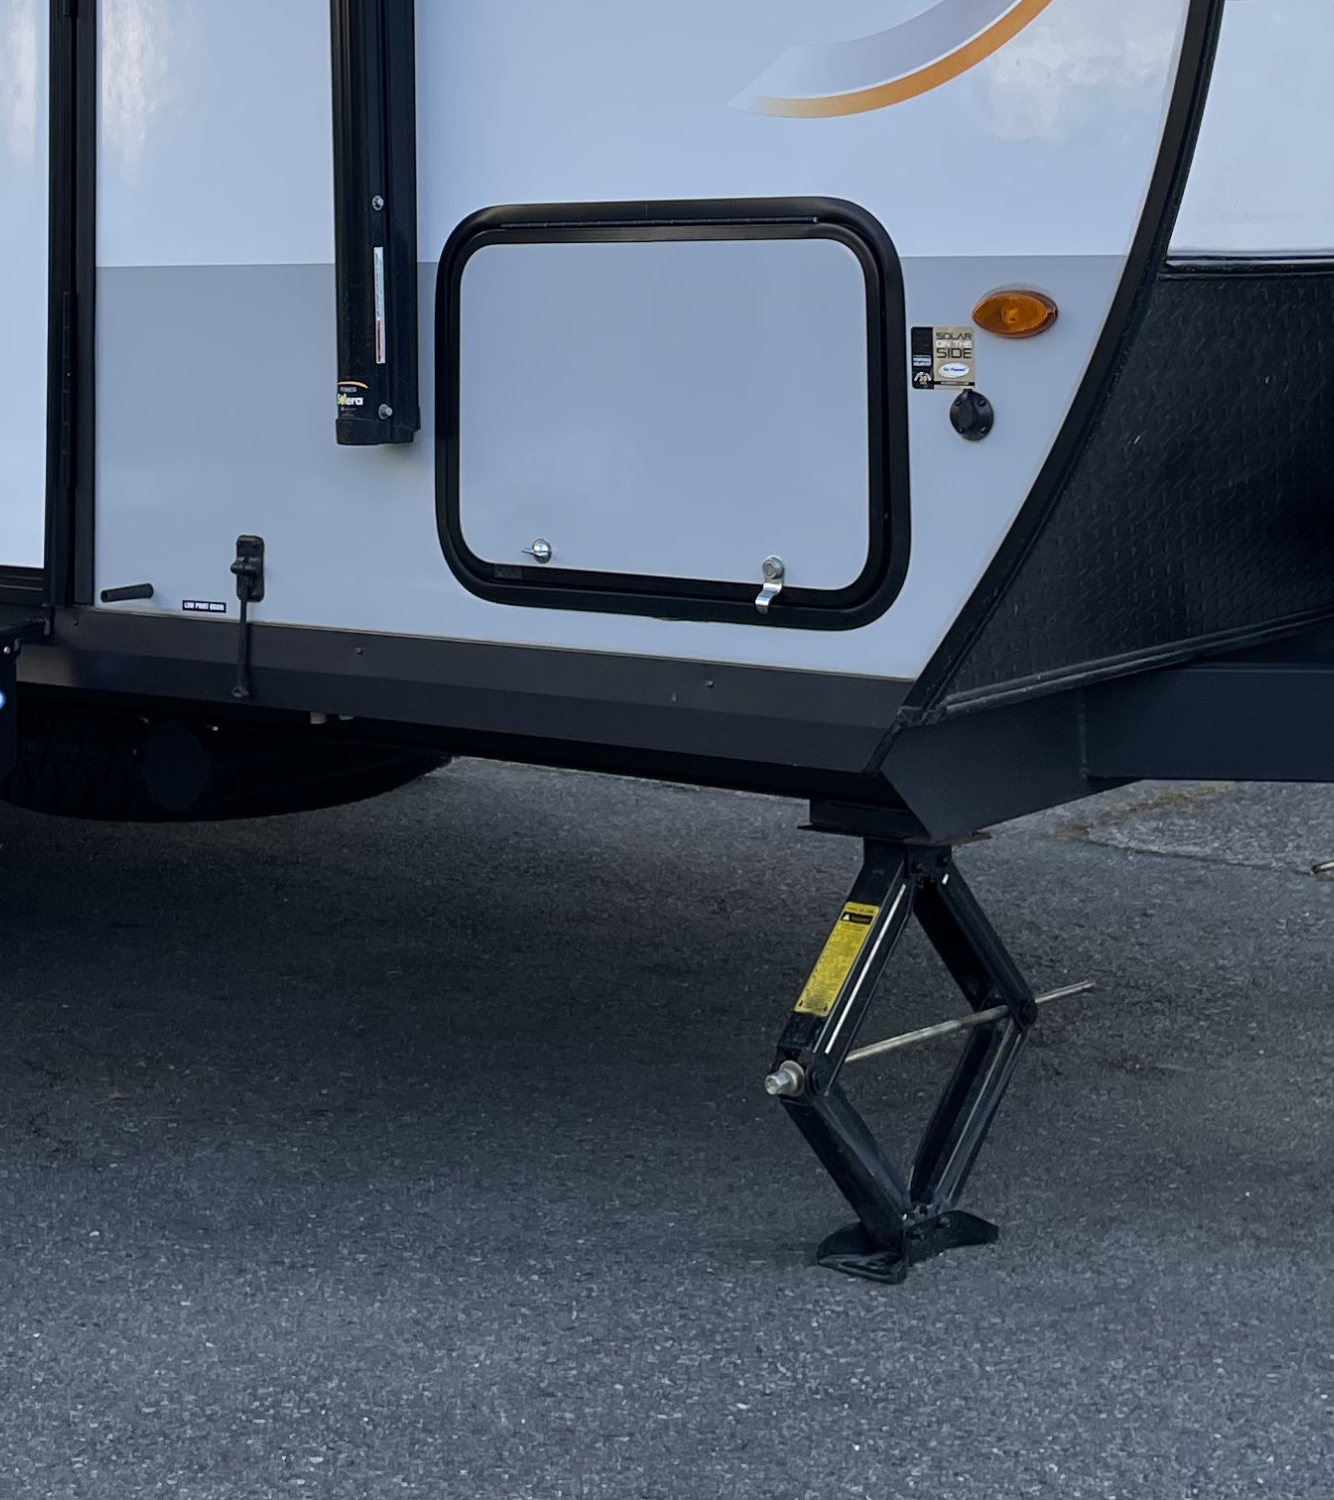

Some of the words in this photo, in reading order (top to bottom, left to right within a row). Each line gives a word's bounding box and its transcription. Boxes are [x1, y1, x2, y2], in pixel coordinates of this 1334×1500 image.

[935, 331, 972, 340] SOLAR
[935, 340, 951, 348] ON
[952, 340, 972, 348] THE
[936, 347, 973, 359] SIDE
